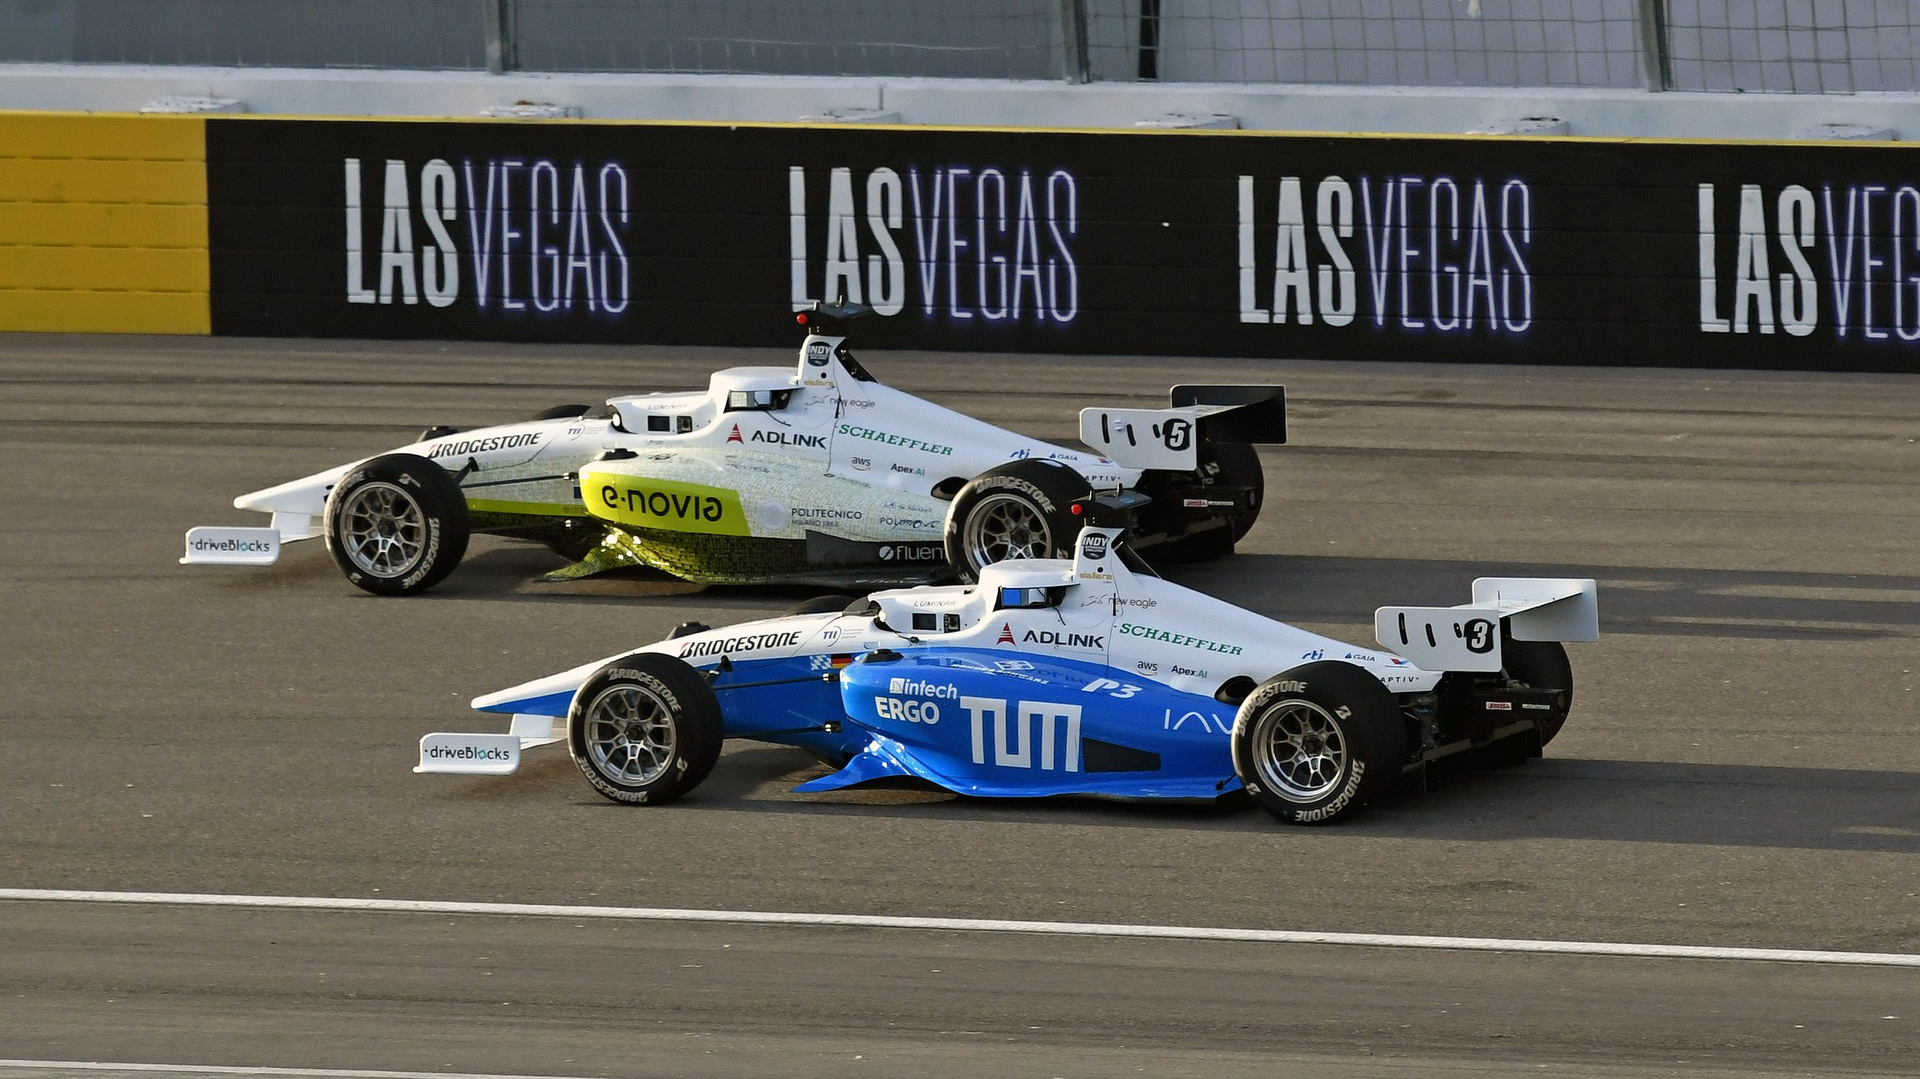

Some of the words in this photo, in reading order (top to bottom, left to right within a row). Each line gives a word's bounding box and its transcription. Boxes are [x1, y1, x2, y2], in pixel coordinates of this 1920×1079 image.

[807, 345, 832, 355] INDY
[850, 400, 876, 410] eagle
[751, 430, 828, 450] ADLINK
[838, 424, 954, 456] SCHAEFFLER
[1169, 421, 1187, 447] 5
[428, 432, 544, 459] BRIDGESTONE
[1010, 448, 1031, 459] rti
[852, 456, 871, 467] aws
[1056, 453, 1078, 462] GAIA
[891, 463, 926, 477] Apex.AI
[976, 475, 1057, 514] BRIDGESTONE
[791, 508, 863, 520] POLITECNICO
[1082, 537, 1109, 547] INDY
[896, 545, 947, 560] fluen
[1129, 598, 1157, 609] eagle
[678, 631, 803, 659] BRIDGESTONE
[1023, 630, 1106, 651] ADLINK
[1119, 623, 1243, 656] SCHAEFFLER
[1471, 621, 1489, 649] 3
[1301, 649, 1325, 660] rti
[1353, 654, 1376, 663] GAIA
[1137, 660, 1158, 671] aws
[1171, 664, 1208, 679] Apex.AI
[608, 667, 682, 713] BRIDGESTONE
[904, 678, 958, 700] intech
[874, 696, 940, 725] ERGO
[1236, 680, 1308, 738] BRIDGESTONE
[960, 696, 1083, 773] TUM
[578, 756, 649, 803] BRIDGESTONE
[1295, 758, 1366, 822] BRIDGESTONE
